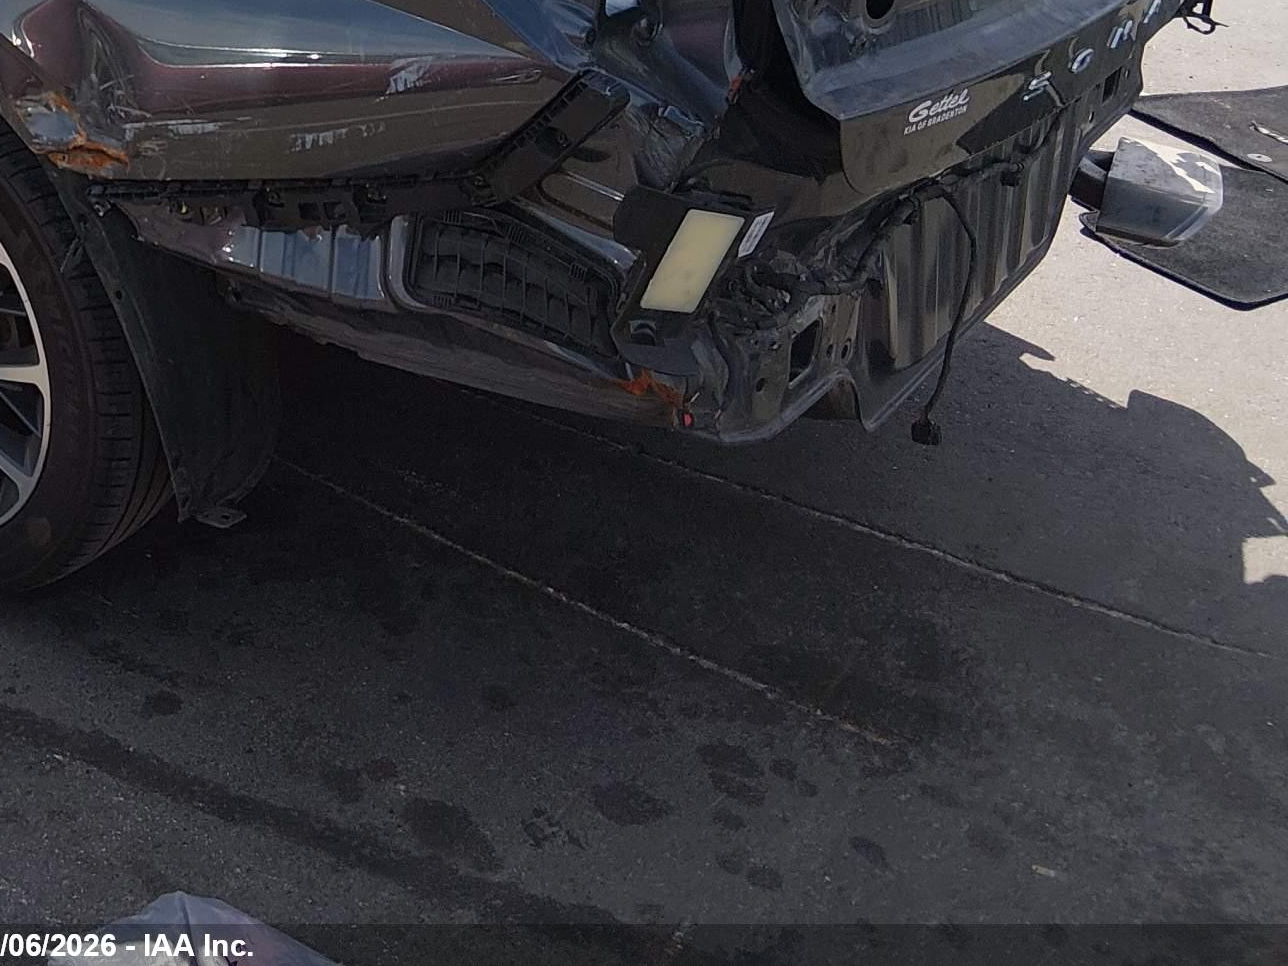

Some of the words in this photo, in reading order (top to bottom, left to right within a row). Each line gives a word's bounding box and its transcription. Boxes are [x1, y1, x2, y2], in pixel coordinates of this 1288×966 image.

[903, 123, 916, 136] KIA
[917, 119, 928, 131] OF
[927, 104, 968, 127] BRADENTON
[908, 88, 970, 122] Gettel
